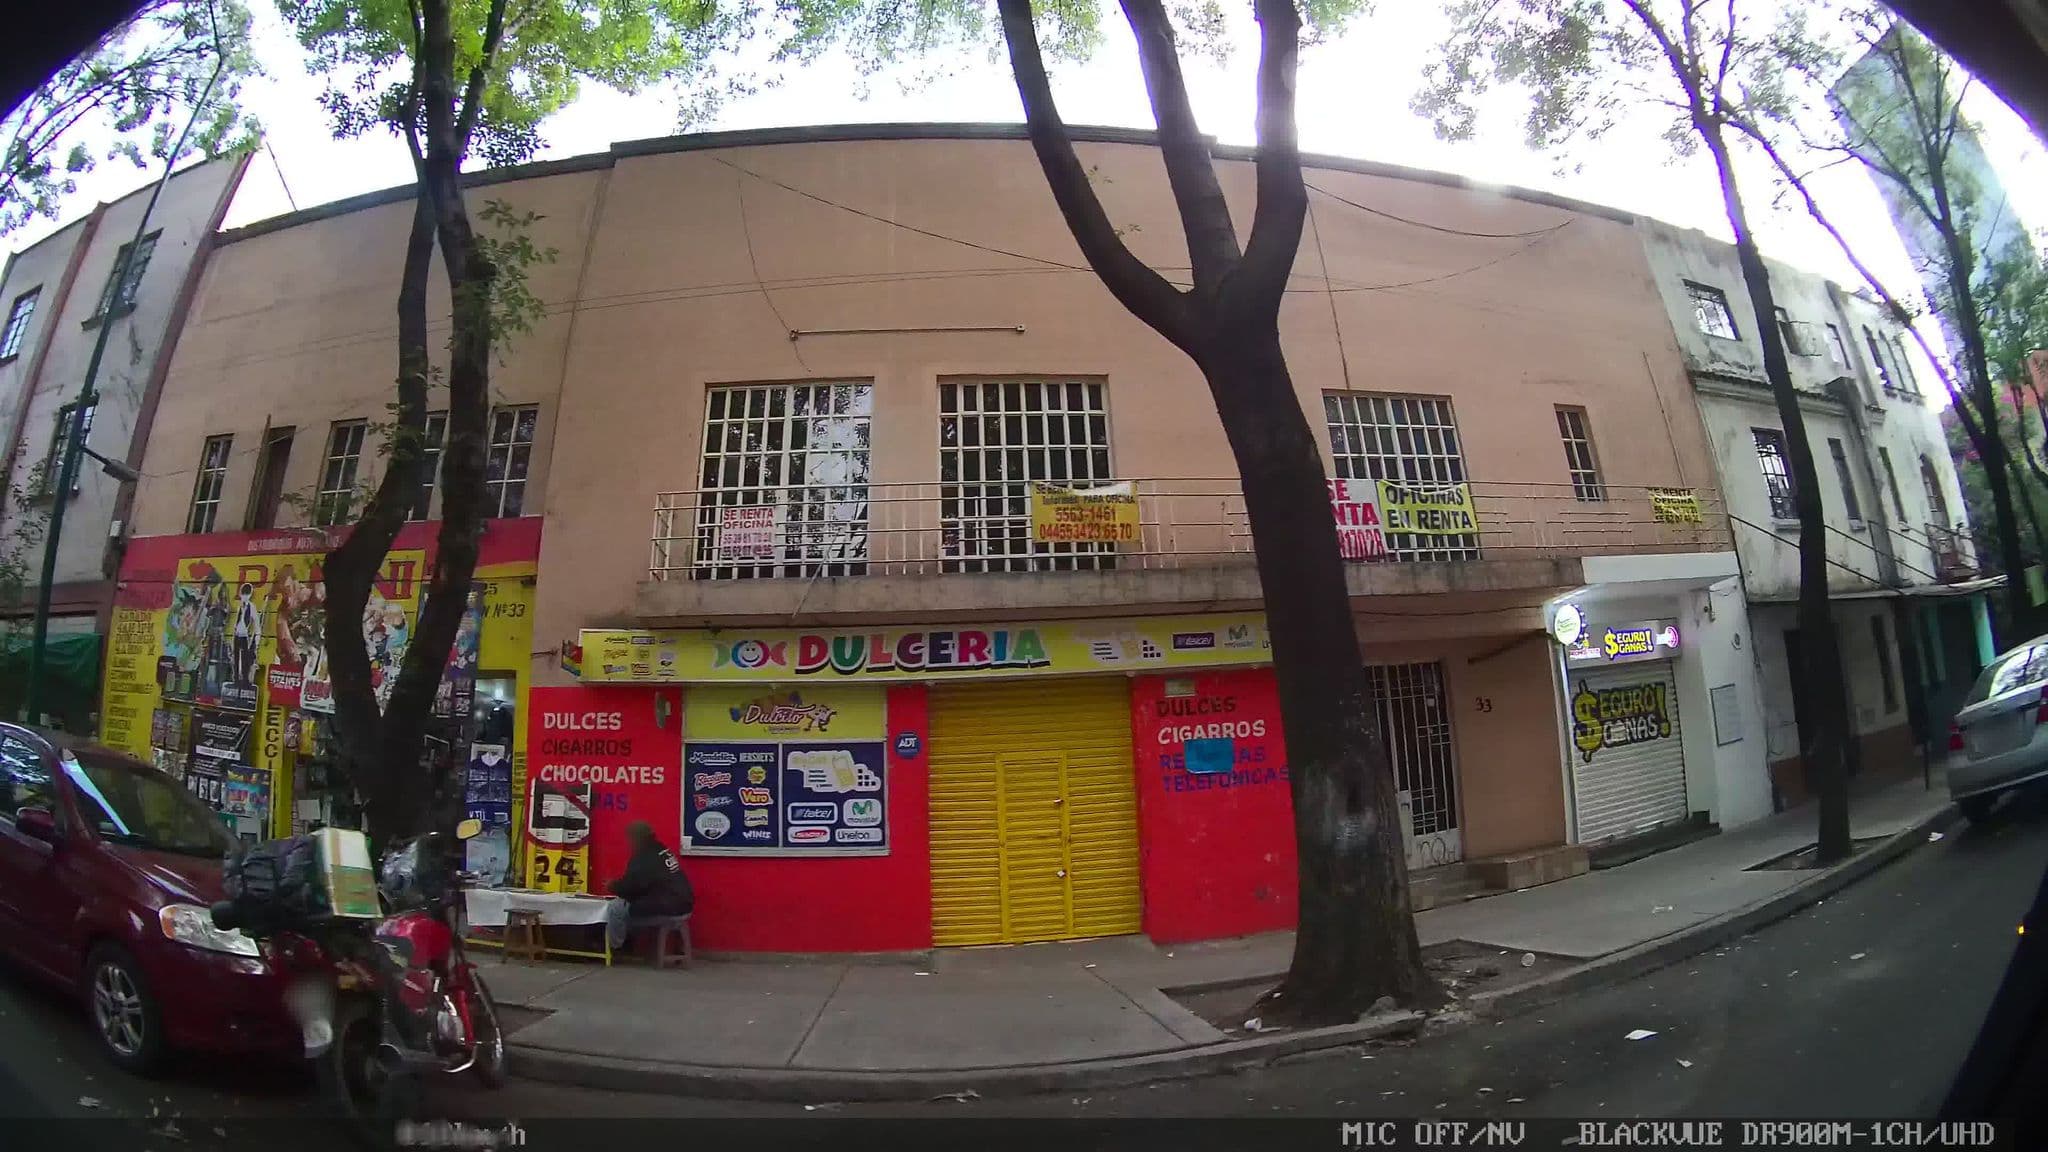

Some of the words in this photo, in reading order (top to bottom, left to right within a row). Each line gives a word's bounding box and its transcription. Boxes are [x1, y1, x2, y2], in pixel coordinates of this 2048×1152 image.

[1385, 484, 1464, 506] OFICINAS
[723, 509, 737, 521] SE
[740, 508, 774, 520] RENTA
[1331, 503, 1379, 526] NTA
[1387, 509, 1411, 529] EN
[1417, 509, 1473, 530] RENTA
[723, 520, 773, 530] OFICINA
[796, 629, 1049, 674] DULCERIA
[1156, 697, 1237, 717] DULCES
[1475, 696, 1493, 713] 33
[543, 711, 622, 730] DULCES
[897, 737, 918, 748] ADT
[1157, 720, 1267, 745] CIGARROS
[541, 736, 633, 756] CIGARROS
[1160, 746, 1266, 771] REAS
[540, 765, 665, 784] CHOCOLATES
